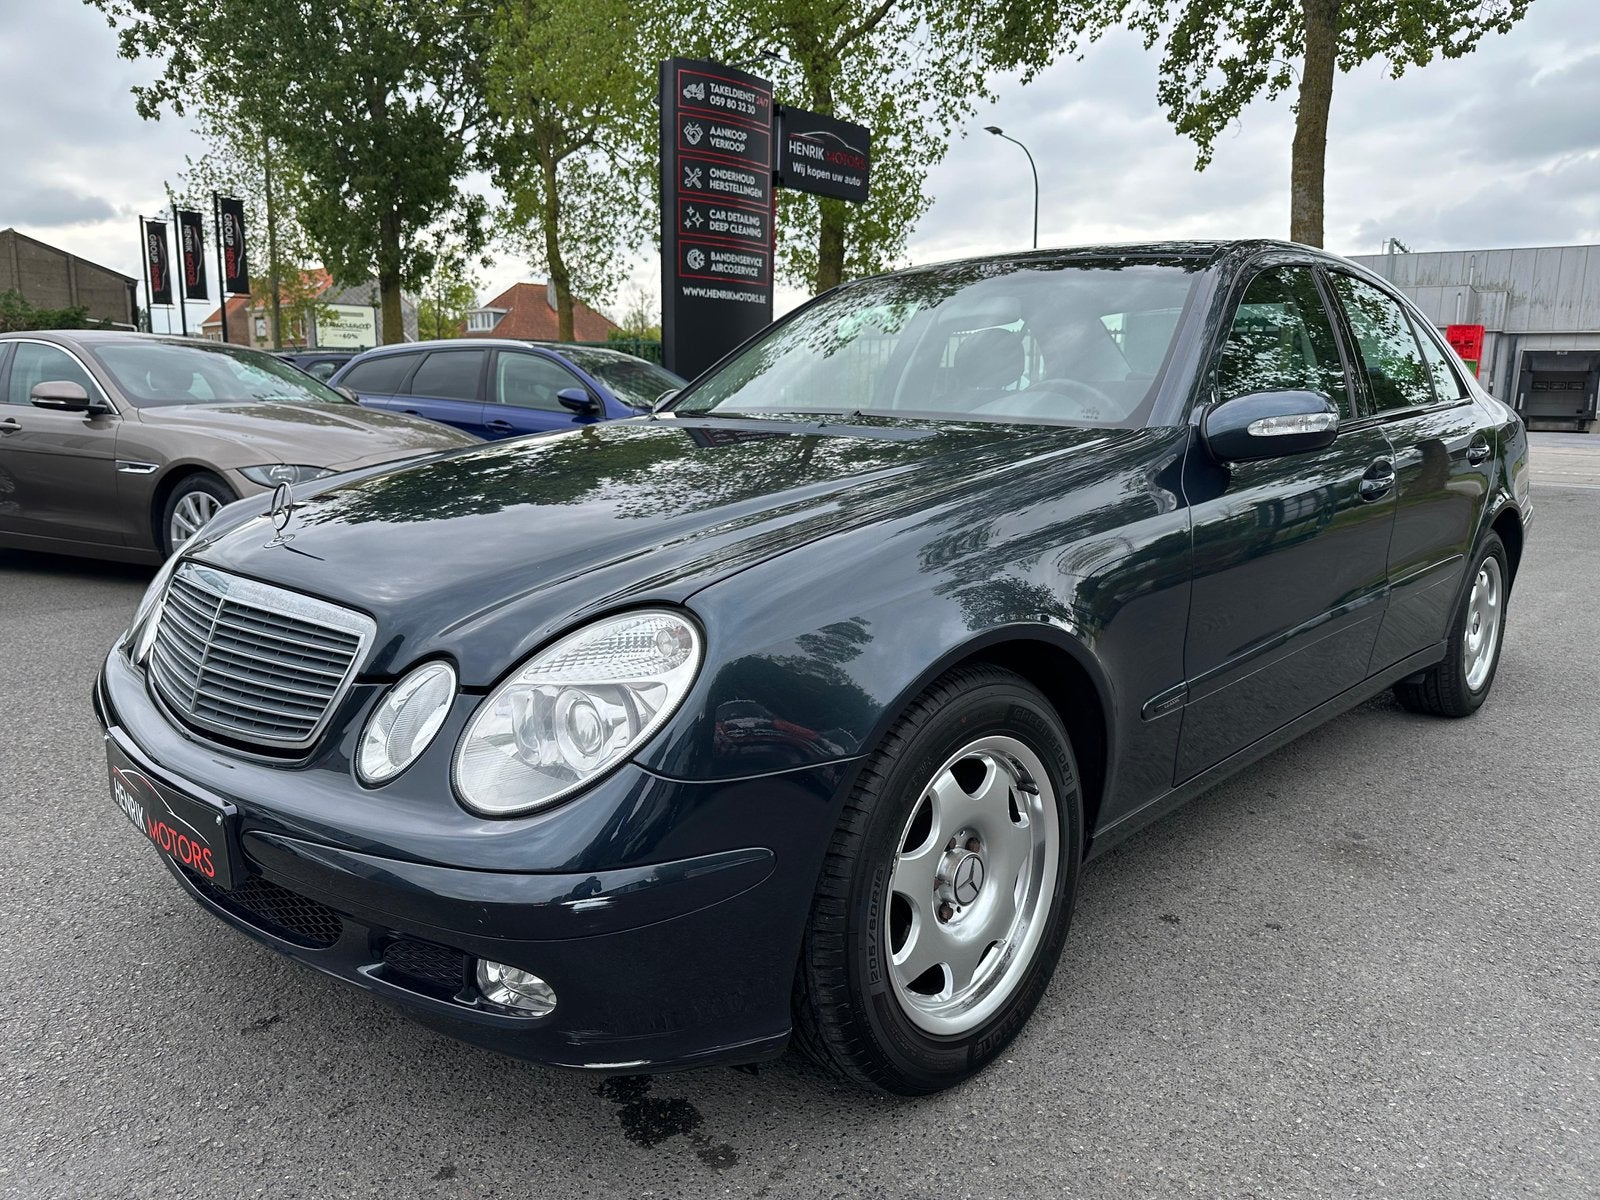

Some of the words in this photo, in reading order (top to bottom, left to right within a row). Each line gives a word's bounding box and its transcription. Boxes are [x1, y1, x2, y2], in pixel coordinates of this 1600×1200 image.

[709, 83, 756, 103] TAKELDIENST
[709, 95, 726, 106] 059
[726, 99, 737, 109] 80
[738, 102, 747, 112] 32
[747, 104, 756, 115] 30
[709, 126, 747, 141] AANKOOP
[709, 137, 746, 153] VERKOOP
[788, 140, 825, 161] HENRIK
[825, 150, 867, 171] MOTORS
[709, 168, 756, 185] ONDERHOUD
[792, 161, 806, 177] Wij
[807, 165, 830, 180] kopen
[832, 173, 843, 182] uw
[844, 175, 861, 187] auto
[709, 180, 762, 198] HERSTELLINGEN
[709, 209, 726, 220] CAR
[727, 212, 760, 226] DETAILING
[183, 224, 193, 253] HENRIK
[223, 213, 235, 247] GROUP
[709, 222, 729, 232] DEEP
[729, 224, 762, 238] CLEANING
[148, 233, 159, 263] GROUP
[710, 251, 763, 267] BANDENSERVICE
[710, 263, 759, 277] AIRCOSERVICE
[682, 286, 767, 304] WWW.HENRIKMOTORS.BE
[113, 777, 147, 834] HENRIK
[147, 813, 215, 878] MOTORS
[867, 866, 884, 982] 205/60R16
